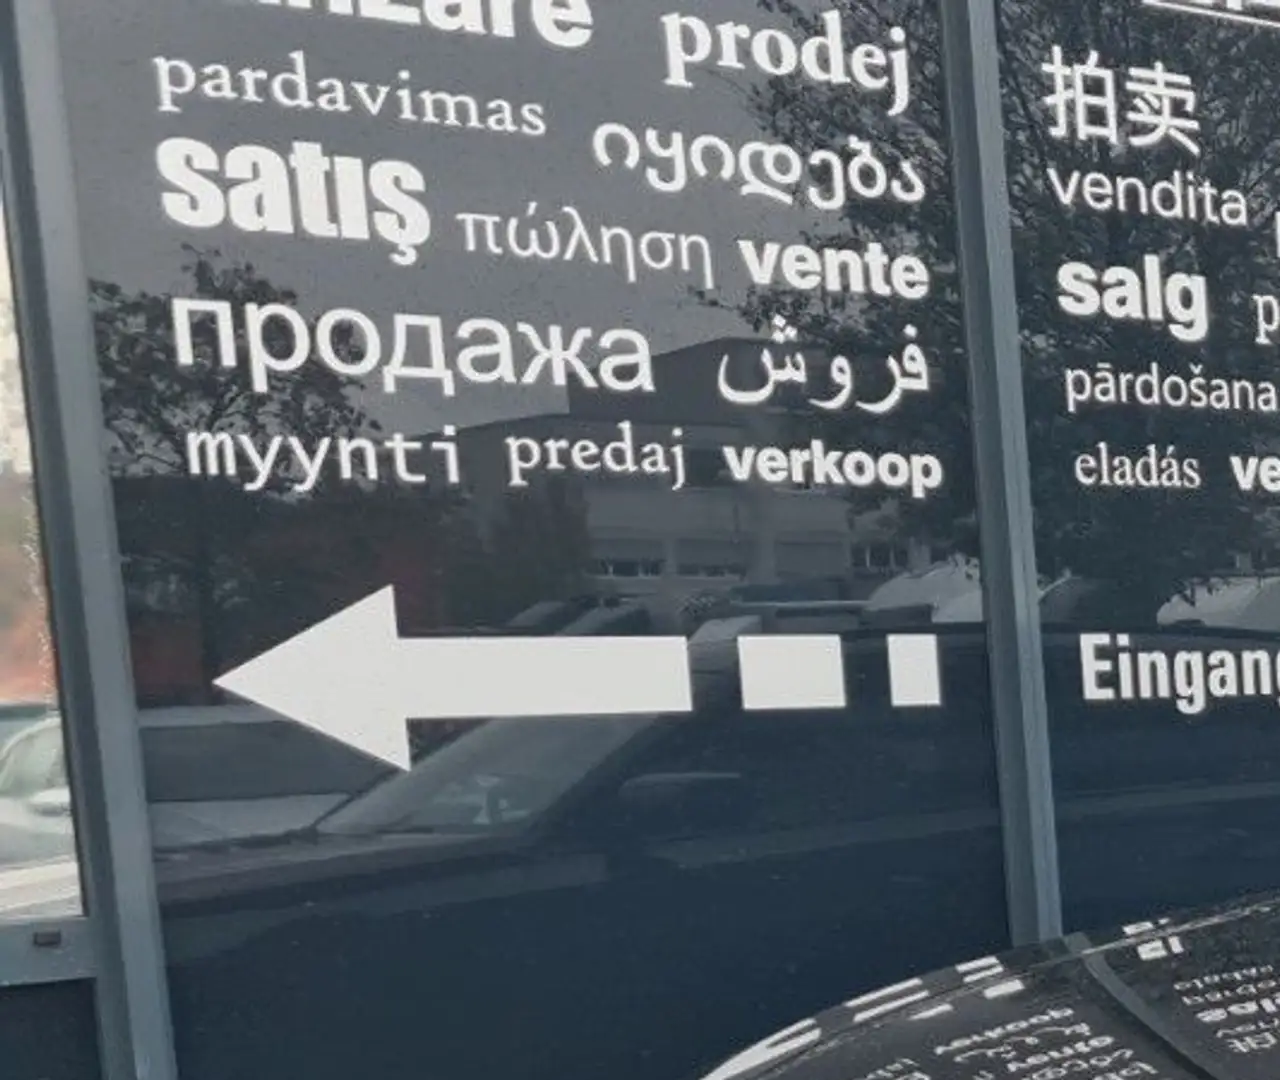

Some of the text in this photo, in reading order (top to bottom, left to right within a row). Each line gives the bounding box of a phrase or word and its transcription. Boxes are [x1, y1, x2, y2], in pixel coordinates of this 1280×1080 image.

[151, 50, 547, 142] pardavimas
[658, 8, 911, 118] prodej
[1039, 44, 1201, 157] 拍卖
[155, 137, 432, 267] satış
[591, 109, 926, 211] იყიდება
[1045, 167, 1249, 227] vendita
[454, 201, 715, 291] πώληση
[735, 239, 930, 300] vente
[1056, 254, 1210, 343] salg
[171, 297, 656, 398] продажа
[716, 313, 930, 415] فروش
[1064, 362, 1279, 414] pārdošana
[185, 420, 944, 500] myynti predaj verkoop
[1074, 441, 1202, 490] eladás
